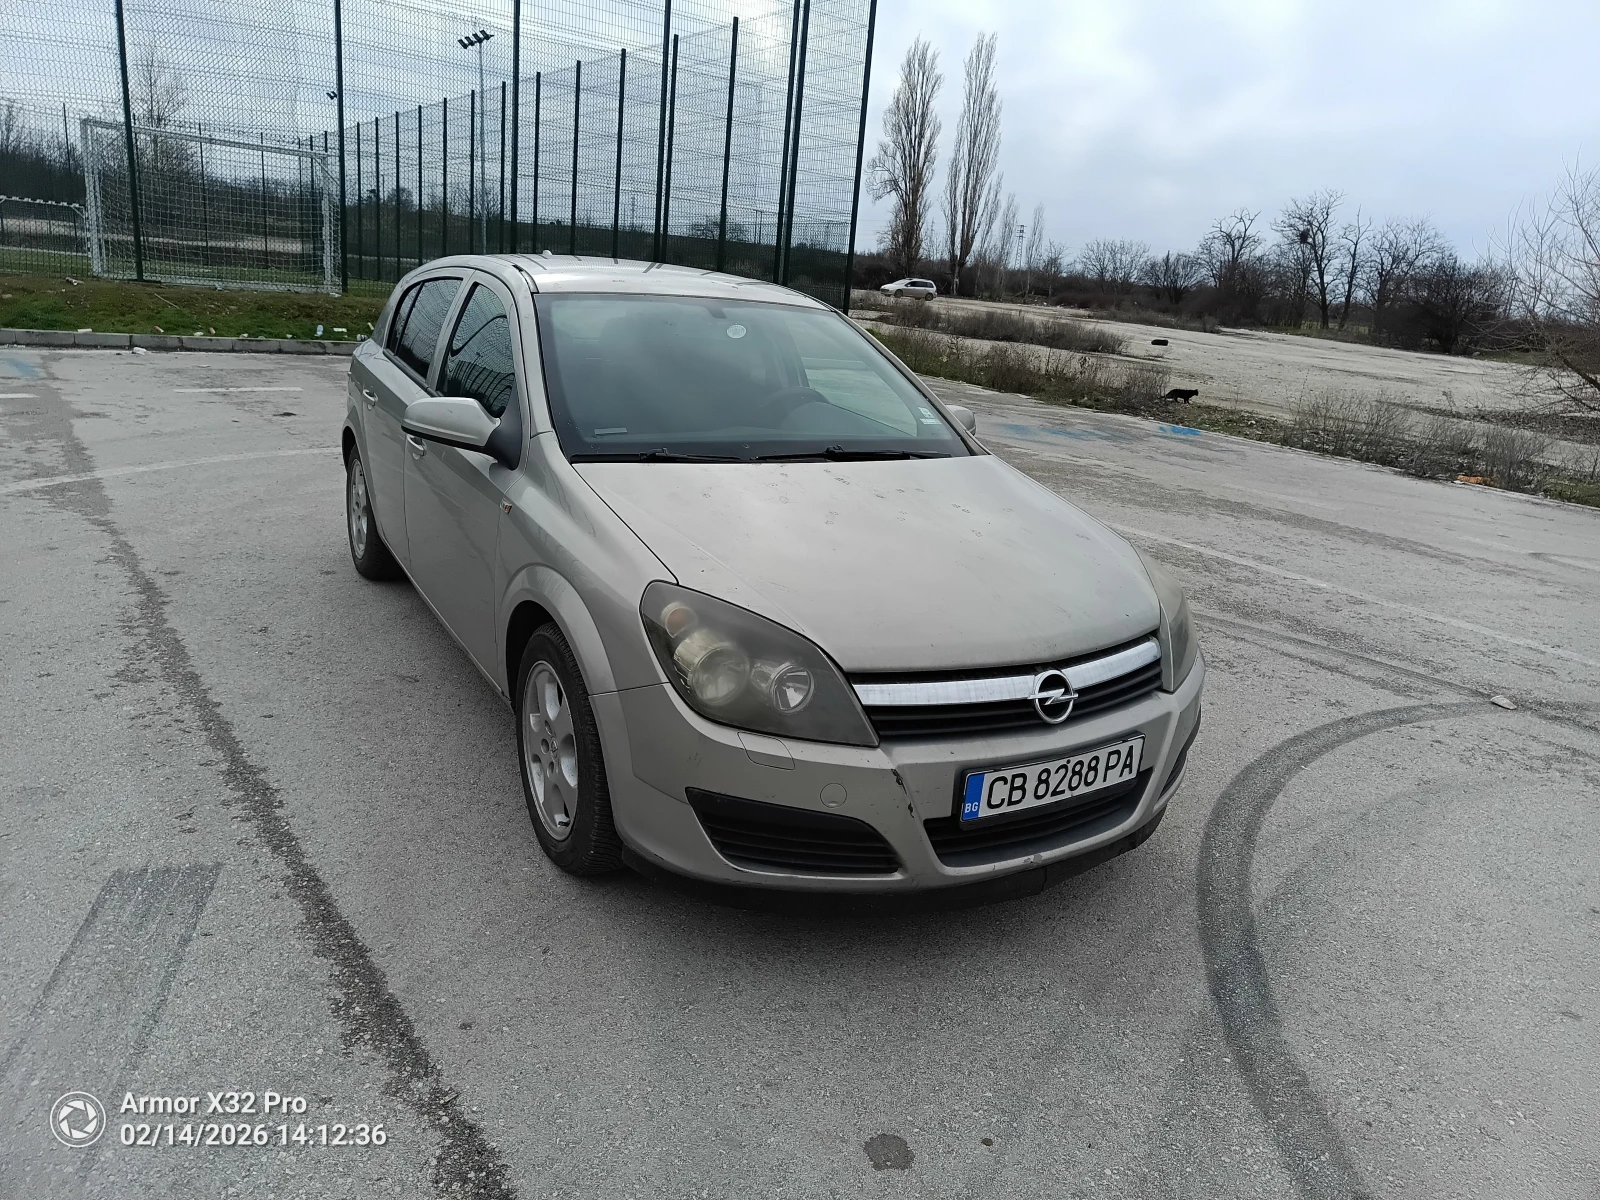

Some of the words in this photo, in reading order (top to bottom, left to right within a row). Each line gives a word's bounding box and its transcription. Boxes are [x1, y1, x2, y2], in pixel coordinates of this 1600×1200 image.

[987, 773, 1028, 810] CB
[1033, 756, 1101, 800] 8288
[1102, 745, 1134, 783] PA
[964, 802, 979, 813] BG
